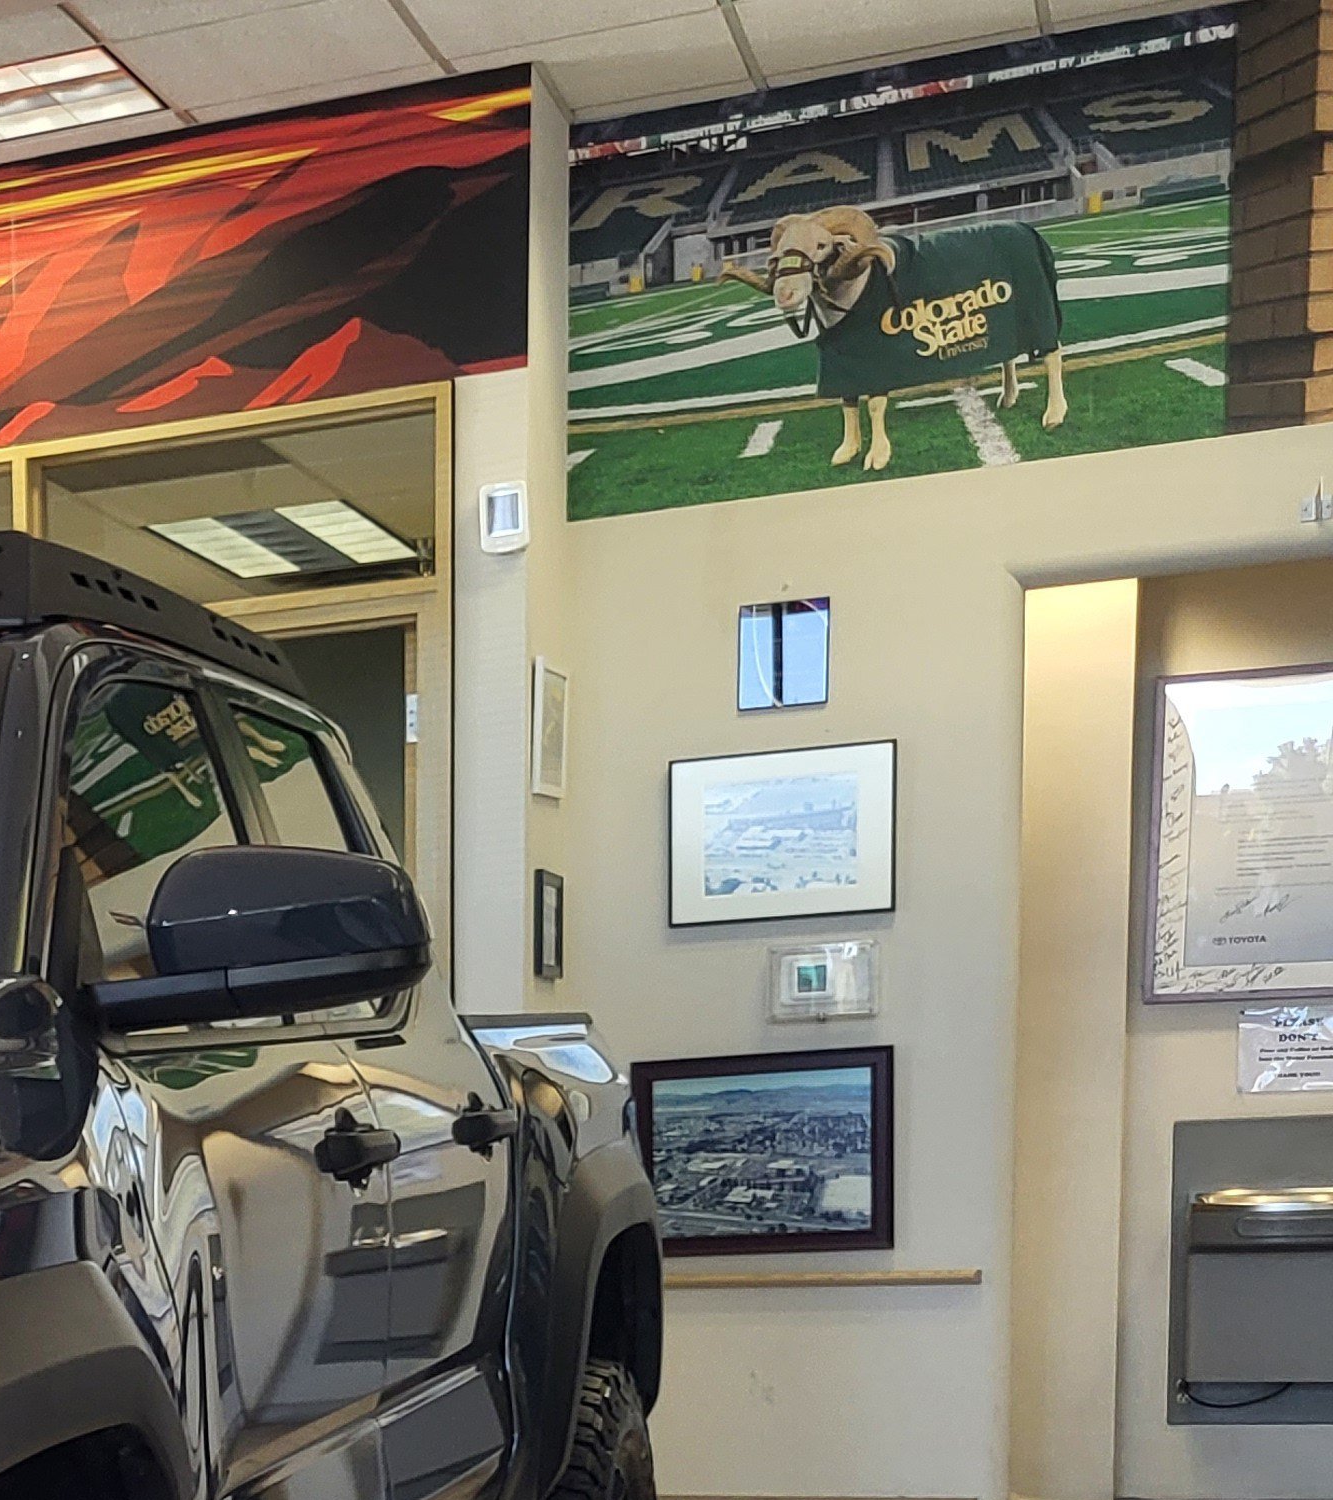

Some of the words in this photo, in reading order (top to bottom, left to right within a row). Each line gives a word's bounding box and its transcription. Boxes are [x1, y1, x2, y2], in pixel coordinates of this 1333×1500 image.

[881, 278, 1012, 335] Colorado
[913, 313, 987, 357] State
[1229, 935, 1267, 944] TOYOTA
